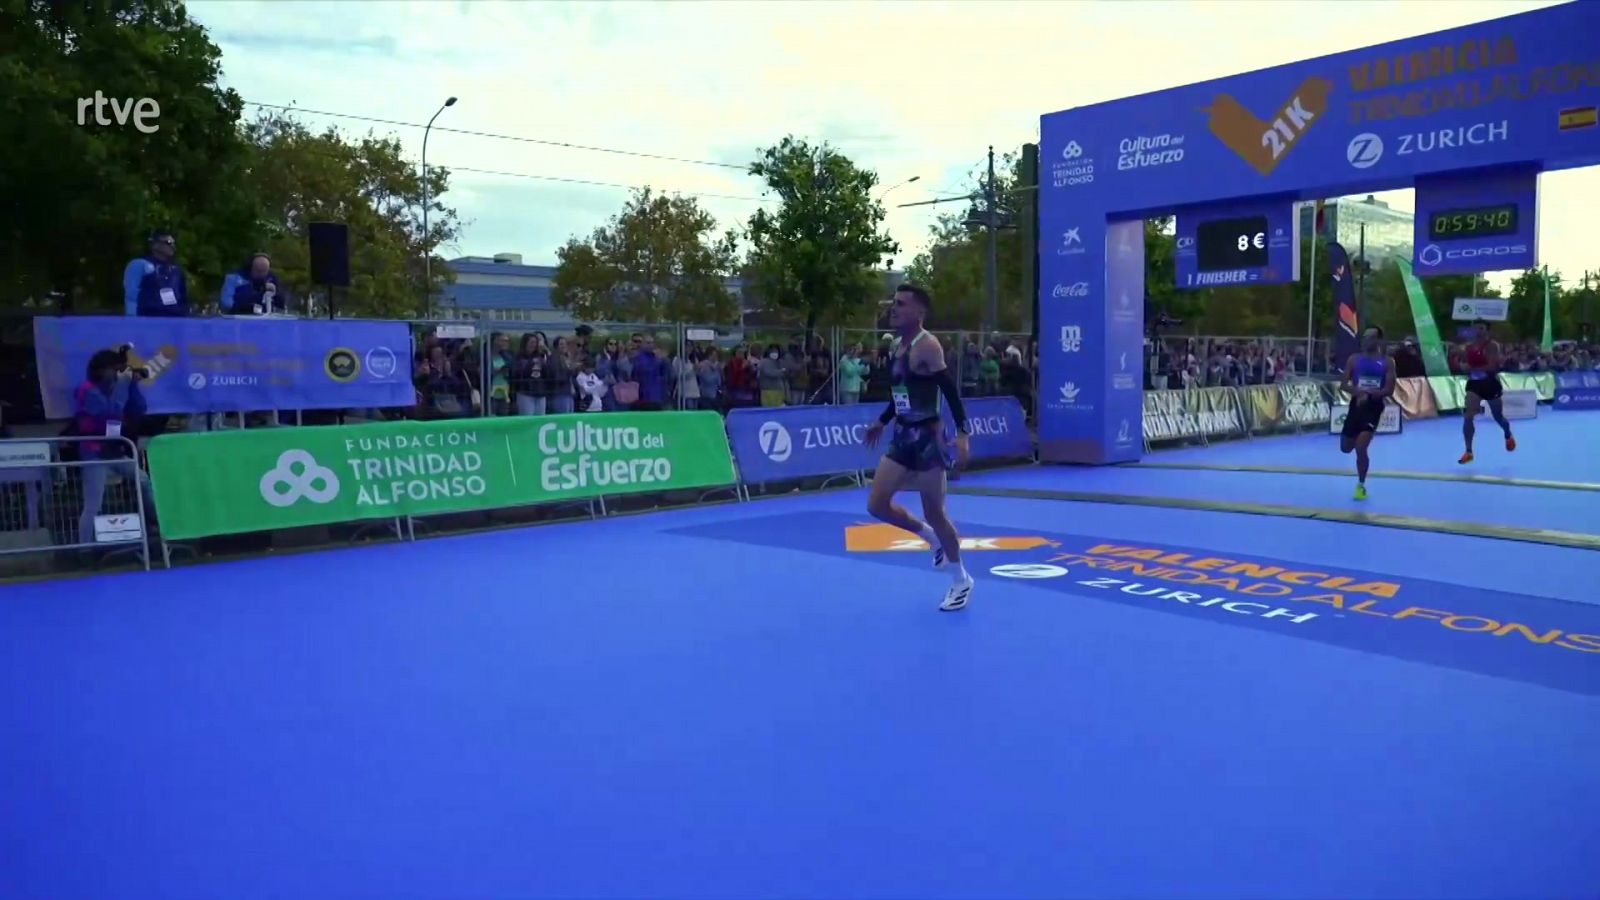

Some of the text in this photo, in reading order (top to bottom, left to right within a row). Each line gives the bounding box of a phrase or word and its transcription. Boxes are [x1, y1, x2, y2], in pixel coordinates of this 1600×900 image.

[1262, 97, 1315, 160] 21K
[1397, 120, 1508, 155] ZURICH
[1119, 134, 1171, 153] Cultura
[1117, 149, 1184, 170] Esfuerzo
[1434, 211, 1510, 233] 0:59:40
[1237, 235, 1249, 251] 8
[1253, 232, 1265, 249] €
[1196, 270, 1247, 285] FINISHER
[212, 376, 258, 386] ZURICH
[538, 421, 664, 455] Cultura del
[800, 424, 868, 448] ZURIC
[347, 451, 482, 480] TRINIDAD
[541, 453, 671, 491] Esfuerzo
[356, 475, 486, 505] ALFONSO
[886, 539, 1002, 550] 2K
[1044, 552, 1293, 596] TRINIDAD
[1086, 543, 1400, 598] VALENCIA
[1075, 576, 1320, 623] ZURICH
